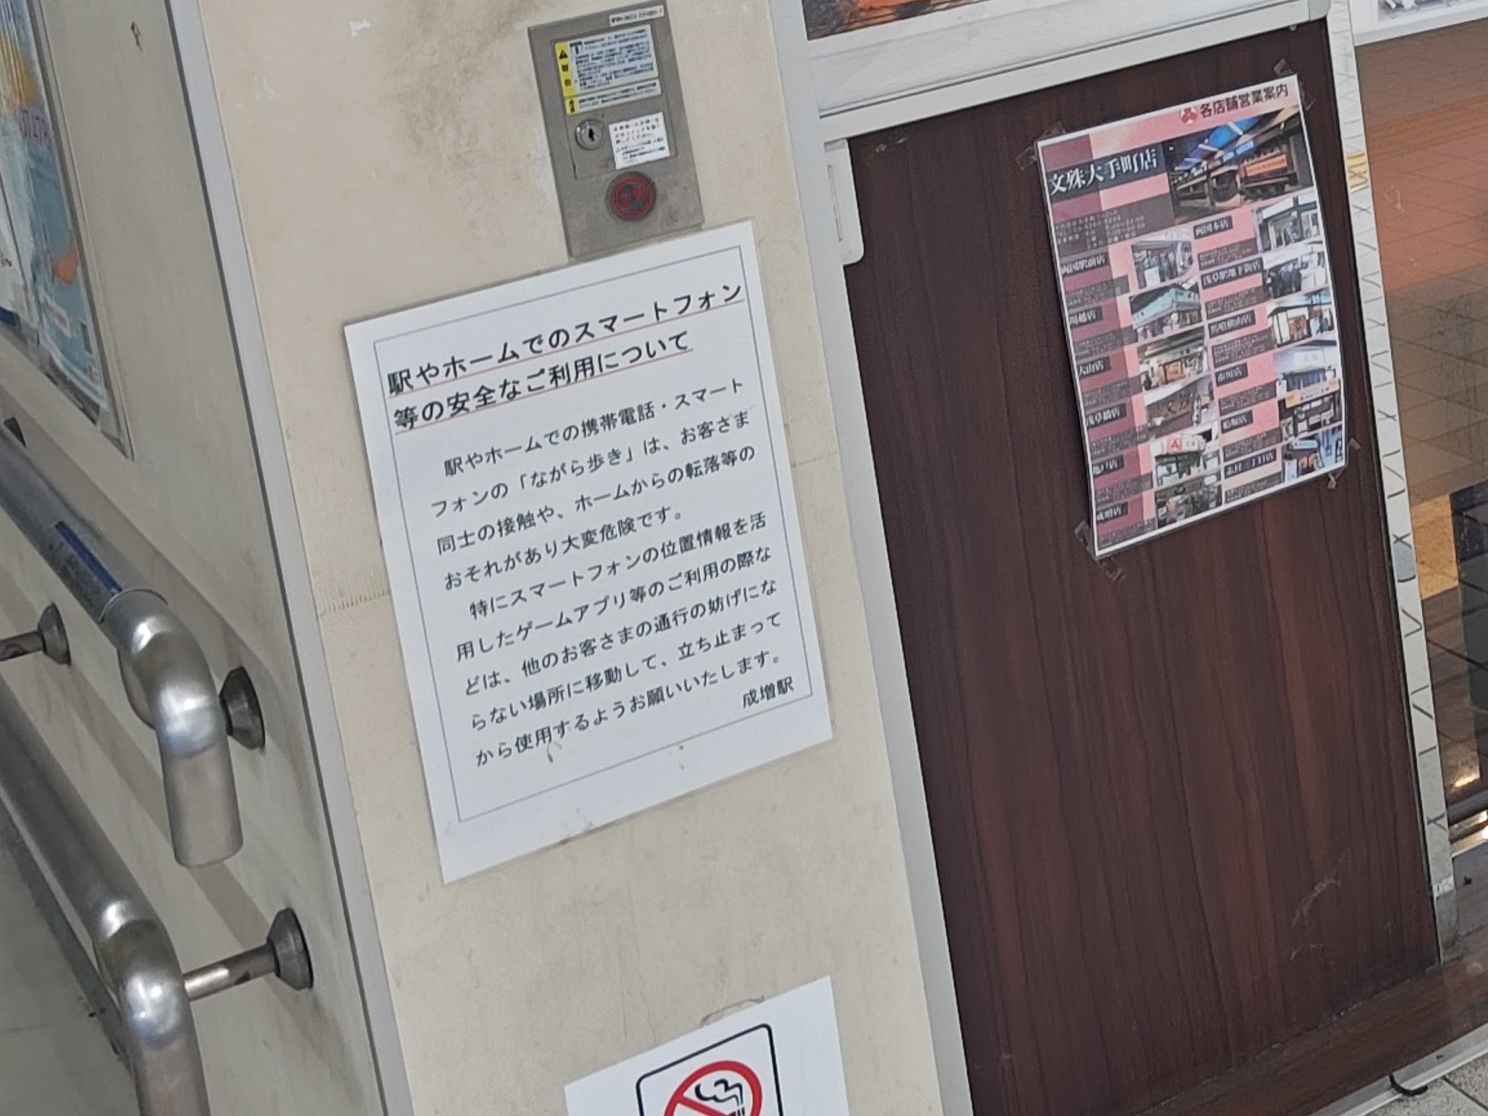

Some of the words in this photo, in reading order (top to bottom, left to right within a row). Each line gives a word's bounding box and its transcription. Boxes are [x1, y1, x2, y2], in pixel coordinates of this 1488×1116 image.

[1199, 83, 1289, 119] 各店舗営業案内
[1048, 146, 1159, 195] 文殊大手町店
[387, 284, 743, 396] 駅やホームでのスマートフォン
[394, 331, 690, 429] 等の安全なご利用について
[431, 410, 750, 518] フォンの「ながら歩き」は、お客さま
[443, 378, 745, 477] 駅やホームでの携帯電話・スマート
[437, 445, 755, 555] 同士の接触や、ホームからの転落等の
[444, 505, 684, 590] おそれがあり大変危険です。
[457, 545, 772, 662] 用したゲームアプリ等のご利用の際な
[470, 512, 767, 620] 特にスマートフォンの位置情報を活
[466, 579, 777, 695] どは、他のお客さまの通行の妨げにな
[471, 612, 782, 730] らない場所に移動して、立ち止まって
[477, 649, 781, 766] から使用するようお願いいたします。
[743, 676, 794, 708] 成増駅
